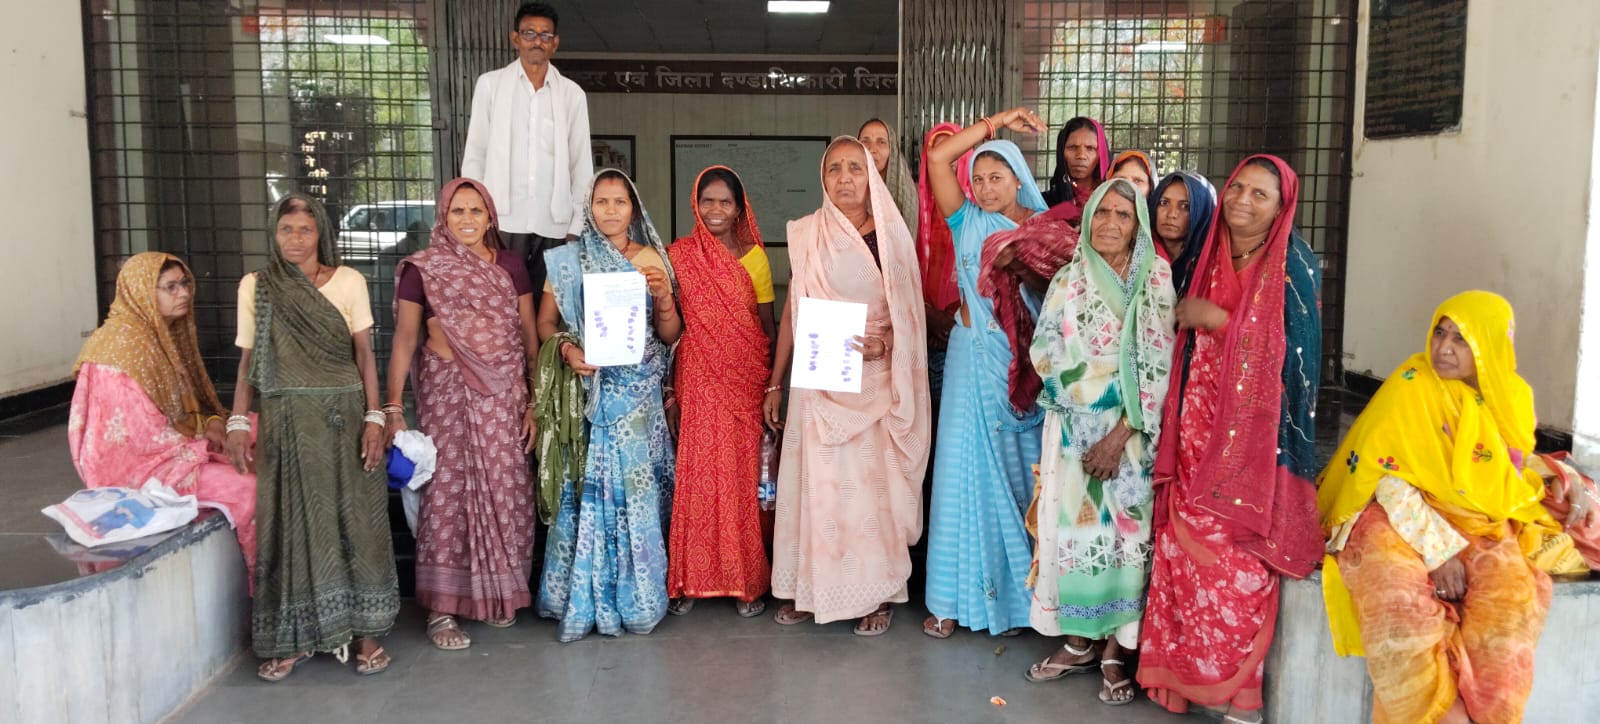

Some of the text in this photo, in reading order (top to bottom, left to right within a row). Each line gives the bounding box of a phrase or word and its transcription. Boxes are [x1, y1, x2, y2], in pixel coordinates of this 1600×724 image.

[615, 64, 647, 92] एवं
[656, 66, 713, 89] जिला
[721, 66, 847, 89] दण्डाधिकारी
